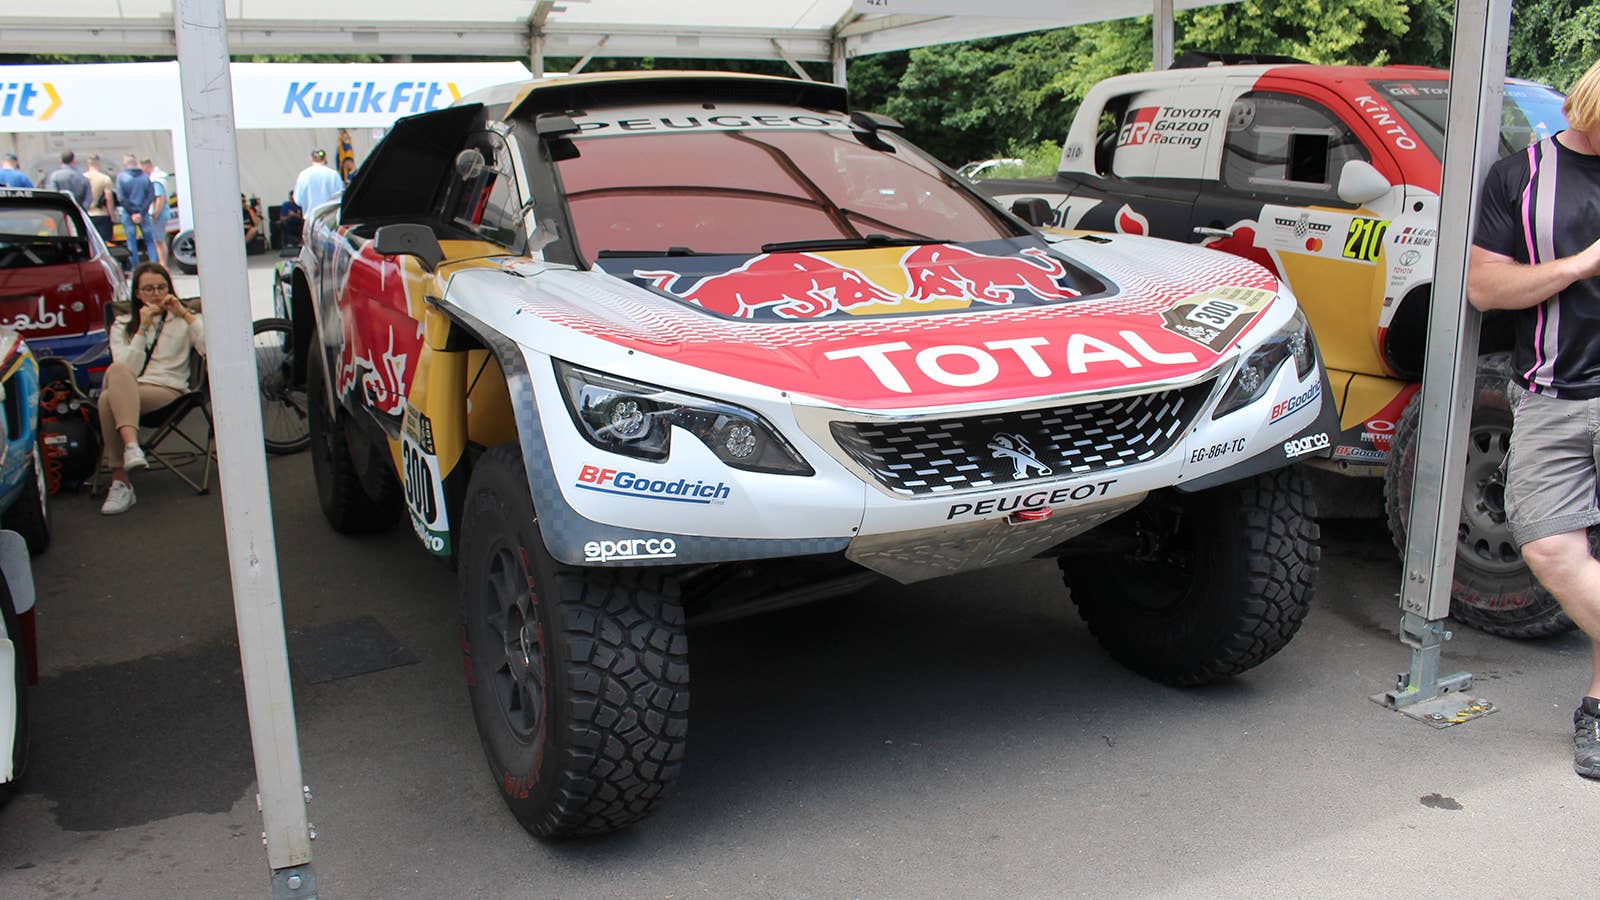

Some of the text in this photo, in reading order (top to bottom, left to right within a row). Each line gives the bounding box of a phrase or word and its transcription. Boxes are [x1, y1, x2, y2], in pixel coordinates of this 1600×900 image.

[0, 82, 38, 117] it
[1162, 107, 1222, 119] TOYOTA
[1148, 133, 1202, 149] Racing
[1154, 120, 1209, 132] GAZOO
[1343, 218, 1391, 262] 210
[1, 296, 67, 330] abi
[1194, 300, 1239, 325] 300
[824, 330, 1198, 393] TOTAL
[1190, 437, 1246, 464] EG-864-TC
[1283, 432, 1329, 457] sparco
[403, 439, 437, 525] 300
[577, 465, 731, 499] BFGoodrich
[946, 480, 1117, 520] PEUGEOT
[584, 538, 677, 563] sparco
